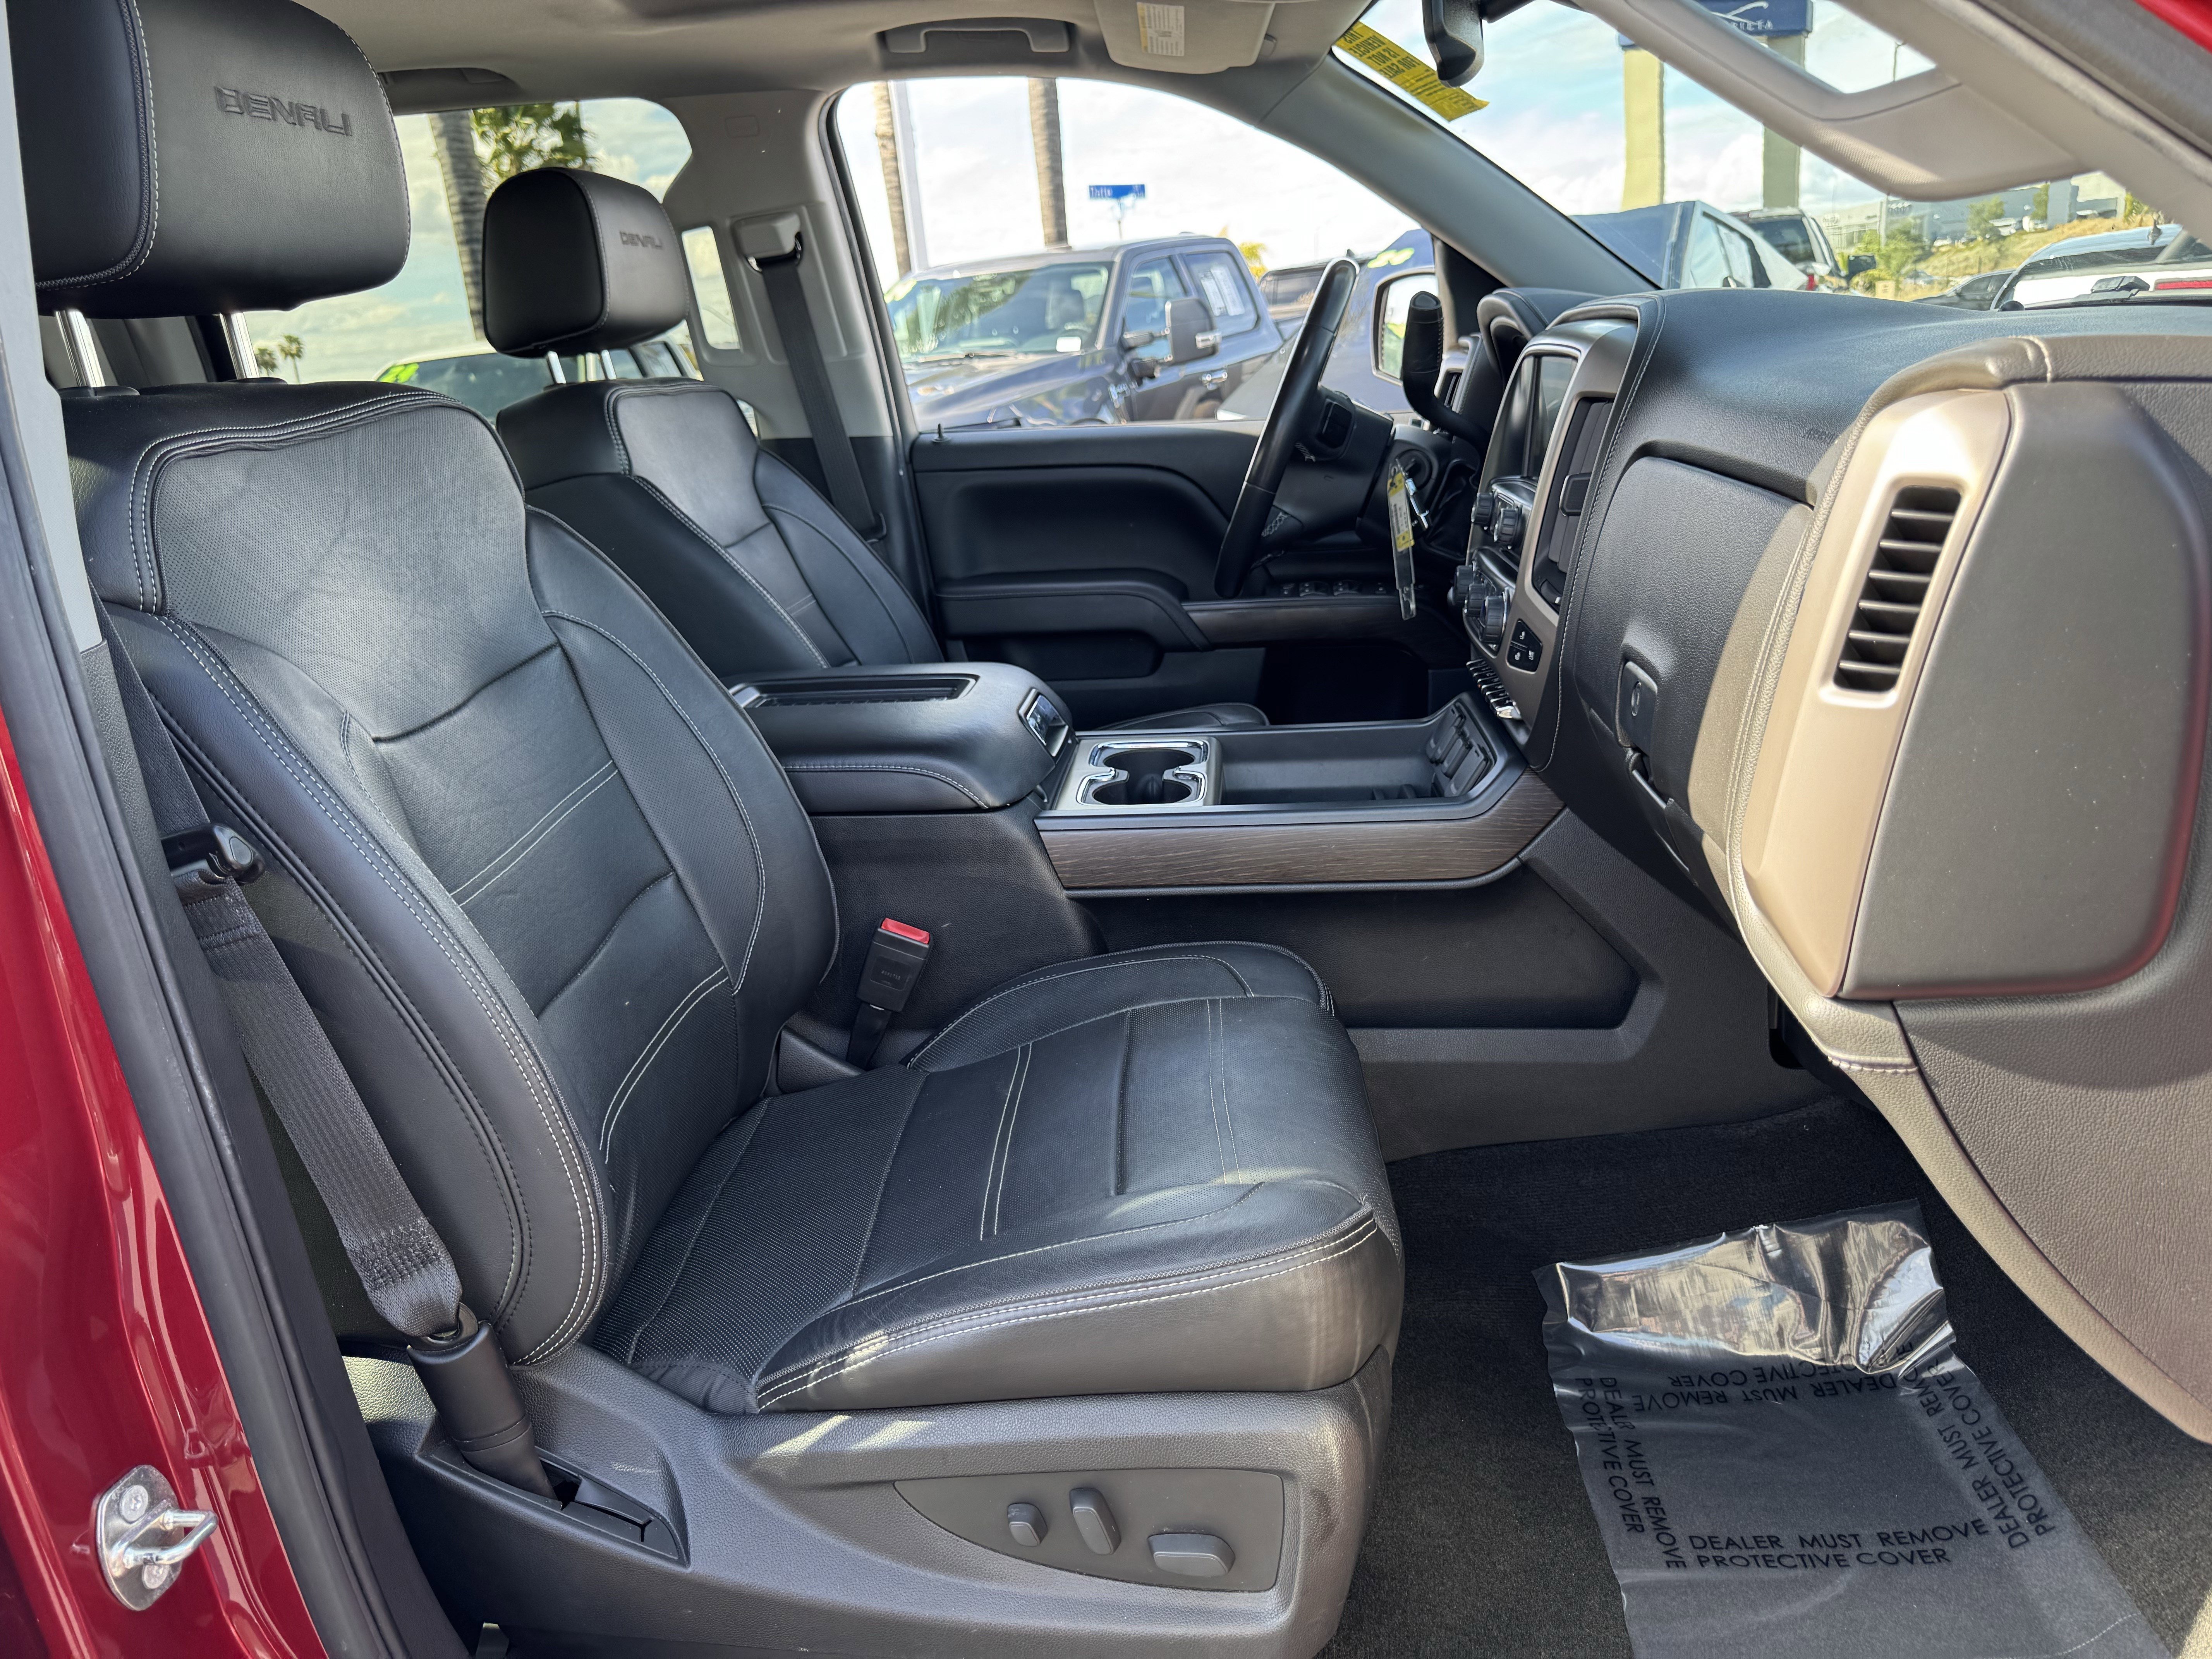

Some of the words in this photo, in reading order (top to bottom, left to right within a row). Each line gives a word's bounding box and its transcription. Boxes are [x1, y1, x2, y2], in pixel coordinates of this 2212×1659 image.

[214, 86, 352, 136] DENALI
[1668, 1369, 1747, 1386] COVER
[1743, 1385, 1798, 1401] MUST
[1810, 1373, 1897, 1397] DEALER
[1927, 1359, 1980, 1425] COVER
[1633, 1390, 1728, 1412] REMOVE
[1937, 1425, 1979, 1469] MUST
[1972, 1426, 2055, 1536] PROTECTIVE
[1608, 1475, 1644, 1533] COVER
[1624, 1439, 1654, 1486] MUST
[1642, 1497, 1686, 1568] REMOVE
[1972, 1475, 2029, 1548] DEALER
[1689, 1535, 1784, 1549] DEALER
[1799, 1533, 1861, 1548] MUST
[1877, 1519, 1989, 1546] REMOVE
[1697, 1553, 1850, 1568] PROTECTIVE
[1856, 1549, 1951, 1565] COVER
